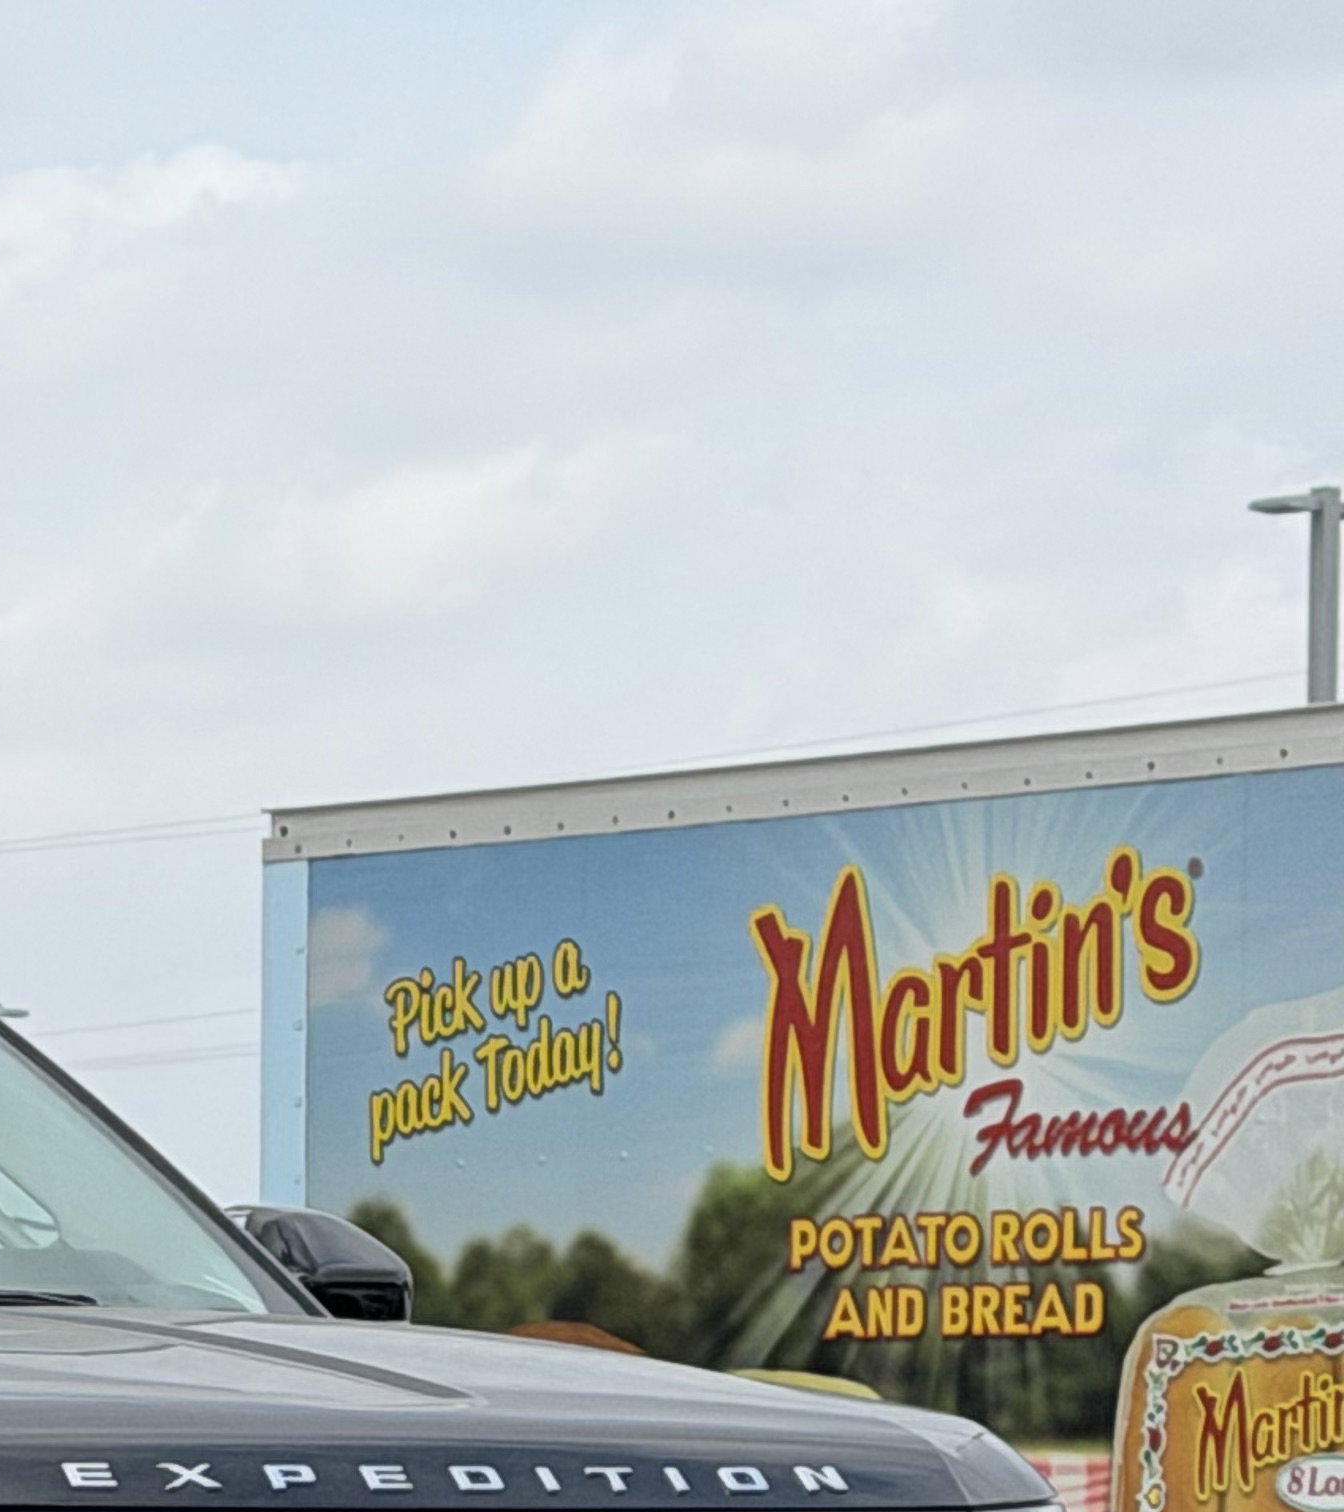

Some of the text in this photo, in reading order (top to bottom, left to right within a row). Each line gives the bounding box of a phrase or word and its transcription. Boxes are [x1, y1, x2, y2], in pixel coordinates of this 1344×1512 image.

[385, 938, 591, 1057] Pick up a
[748, 843, 1199, 1182] Martin's
[369, 990, 622, 1166] pack Today!
[962, 1078, 1199, 1177] Famous
[789, 1206, 1145, 1273] POTATO ROLLS
[822, 1281, 1105, 1342] AND BREAD
[60, 1461, 852, 1494] EXPEDITION
[1287, 1466, 1305, 1495] 8
